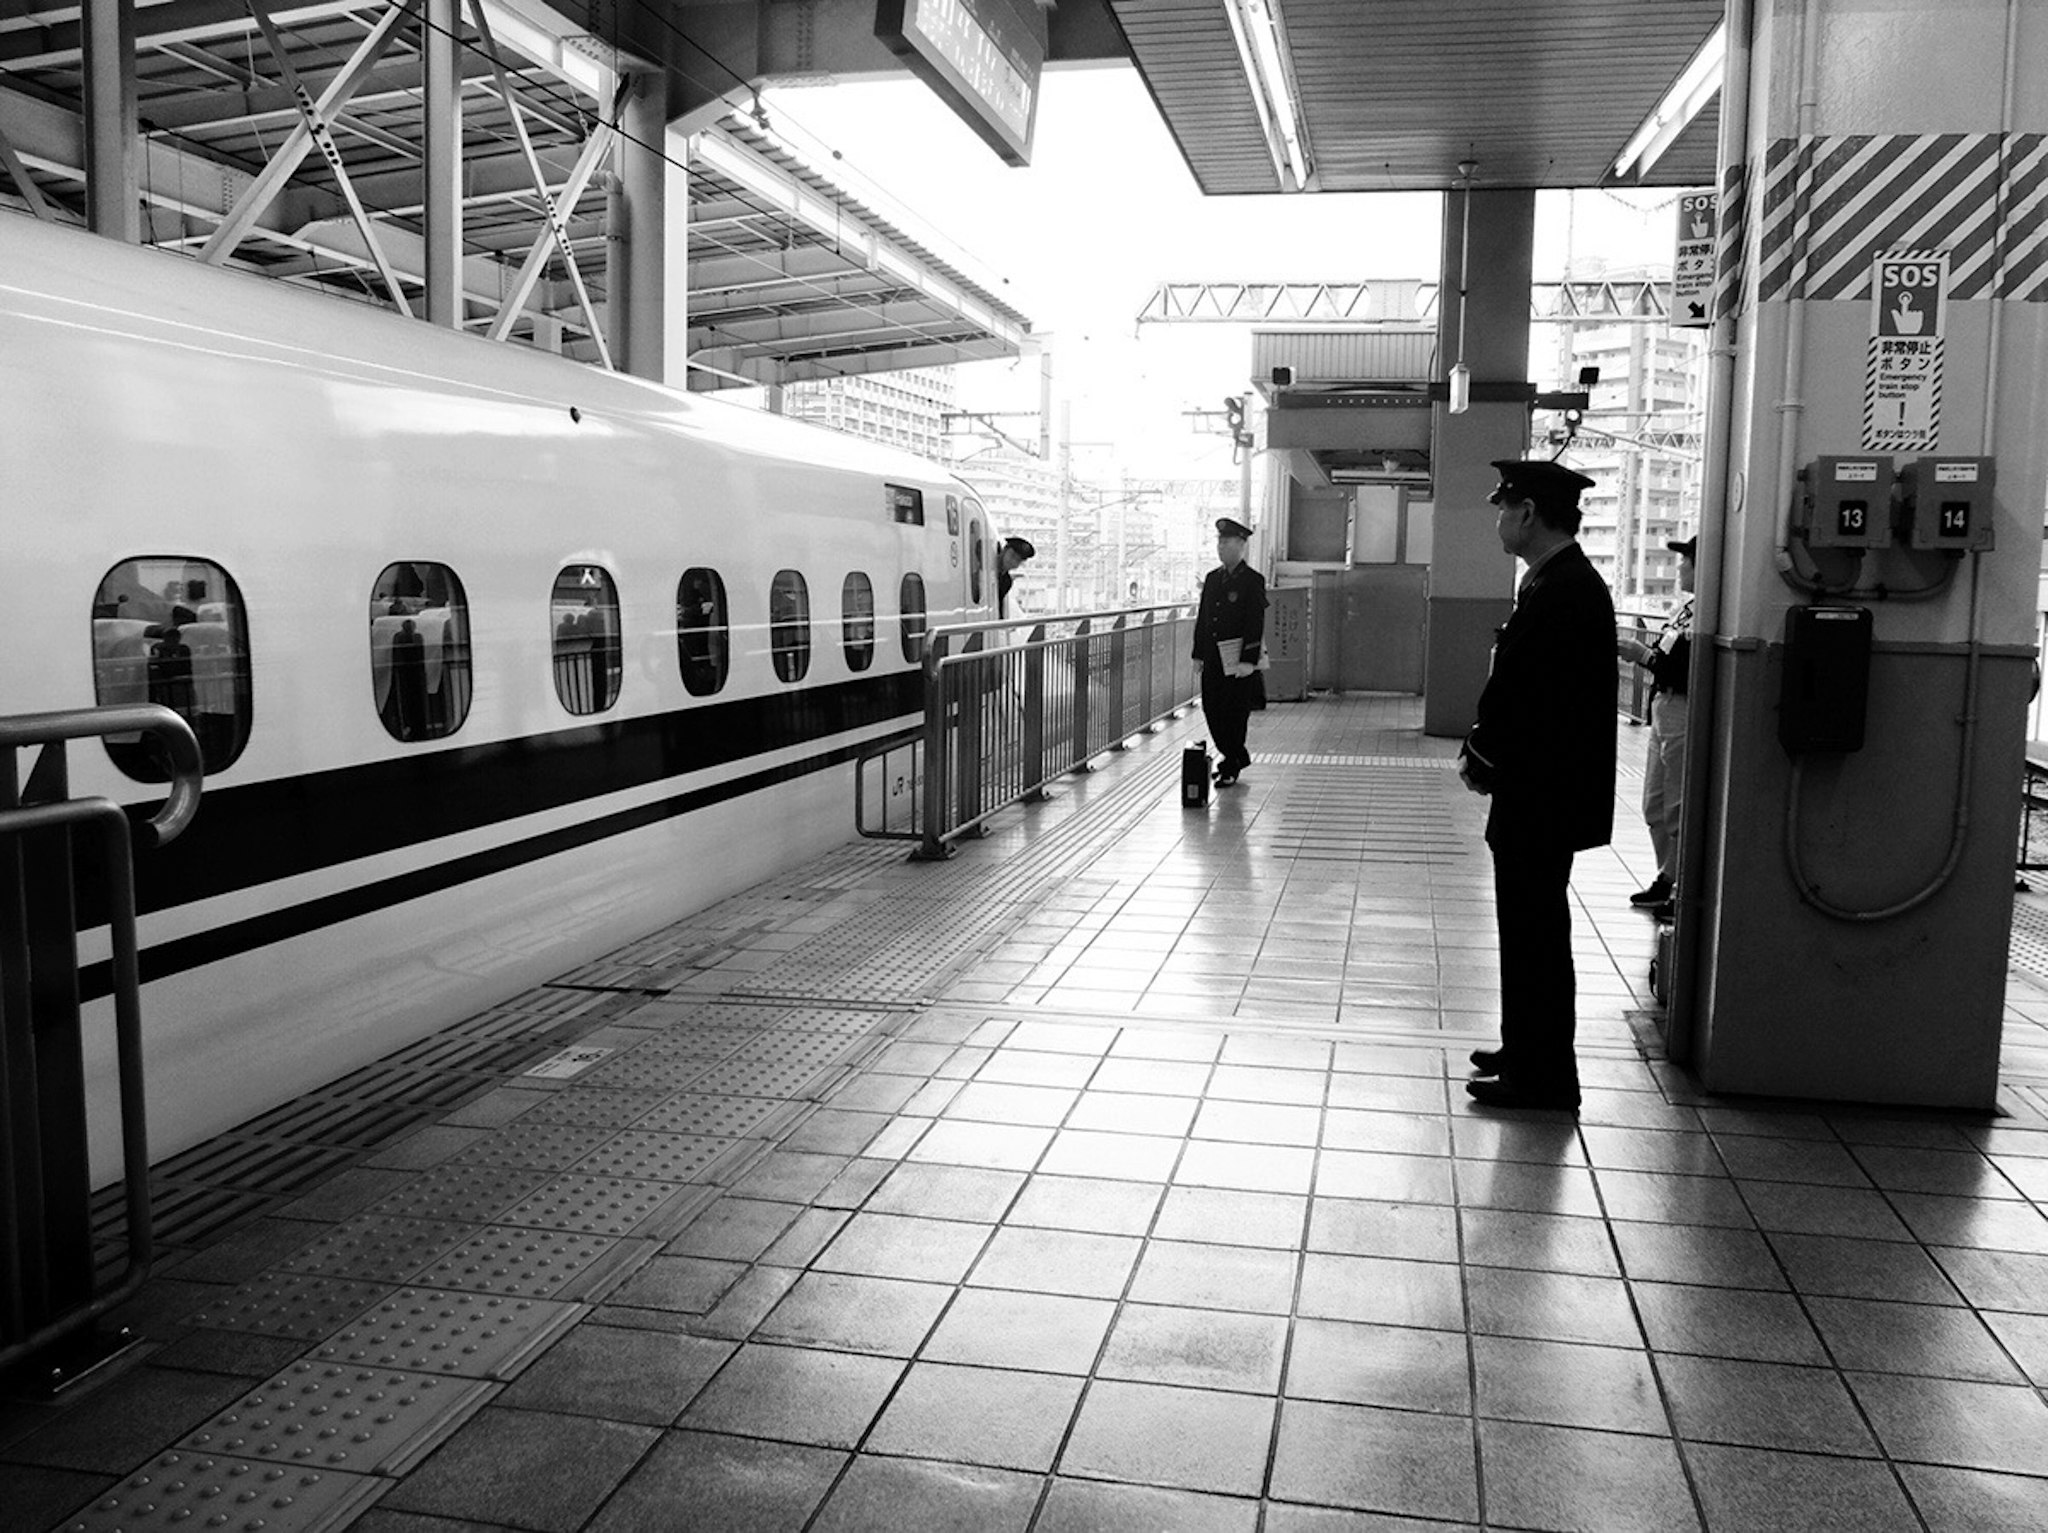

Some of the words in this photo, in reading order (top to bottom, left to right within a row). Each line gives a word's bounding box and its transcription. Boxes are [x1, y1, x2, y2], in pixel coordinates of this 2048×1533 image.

[1678, 244, 1714, 257] 非常停
[1884, 265, 1938, 288] SOS
[1881, 341, 1931, 355] 非常停止
[1881, 357, 1931, 371] ボタン
[1880, 373, 1927, 382] Emergency
[1901, 383, 1920, 391] stop
[1842, 508, 1863, 528] 13
[1944, 509, 1965, 529] 14
